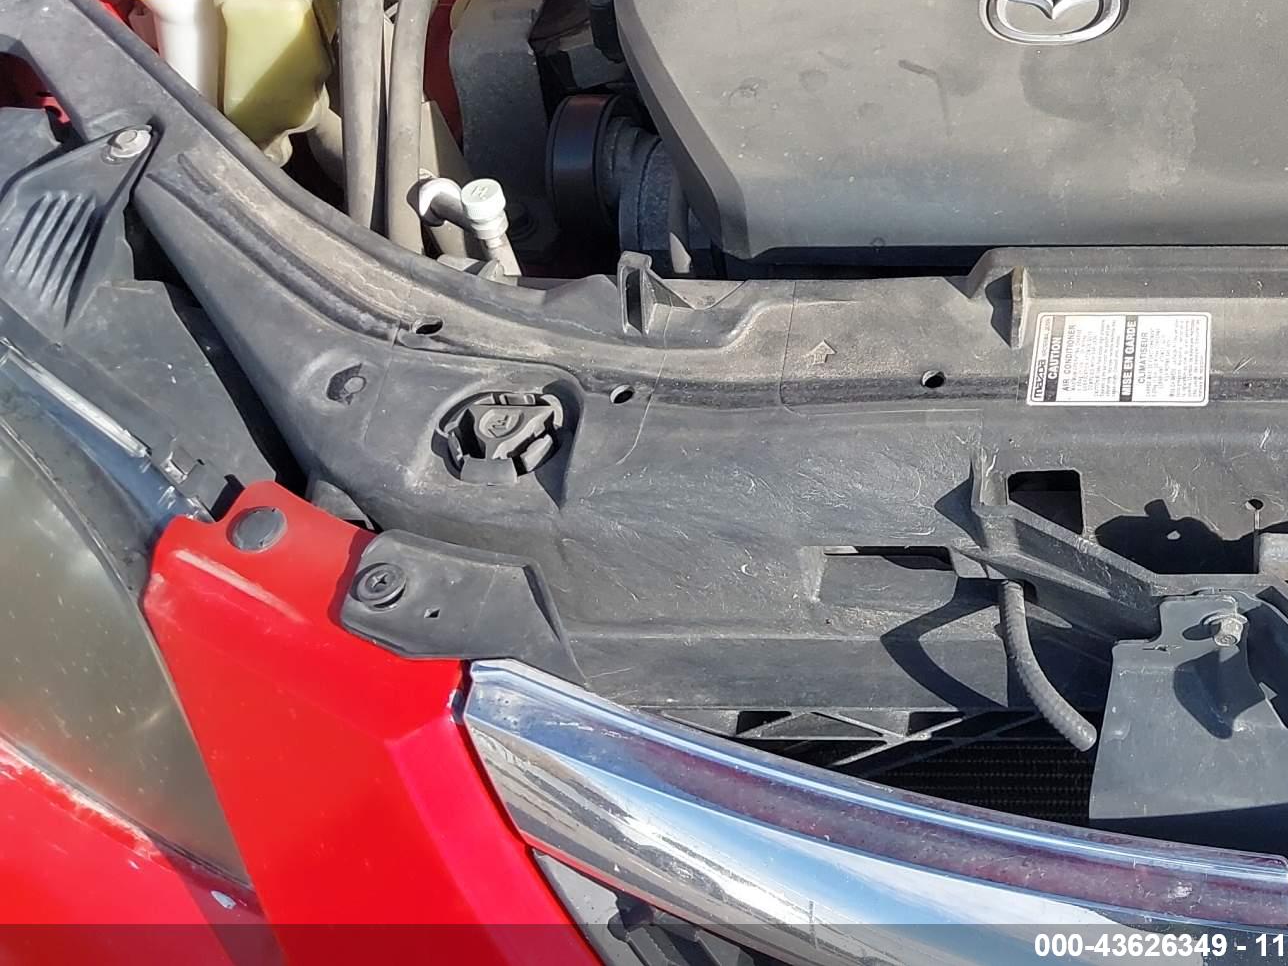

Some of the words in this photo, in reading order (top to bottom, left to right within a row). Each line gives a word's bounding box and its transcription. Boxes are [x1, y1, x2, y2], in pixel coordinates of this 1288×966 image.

[1124, 320, 1137, 355] GARDE
[1048, 336, 1063, 380] CAUTION
[1123, 356, 1134, 369] EN
[1137, 332, 1149, 384] CLIMATISEUR
[1062, 379, 1071, 391] AIR
[1121, 372, 1133, 396] MISE
